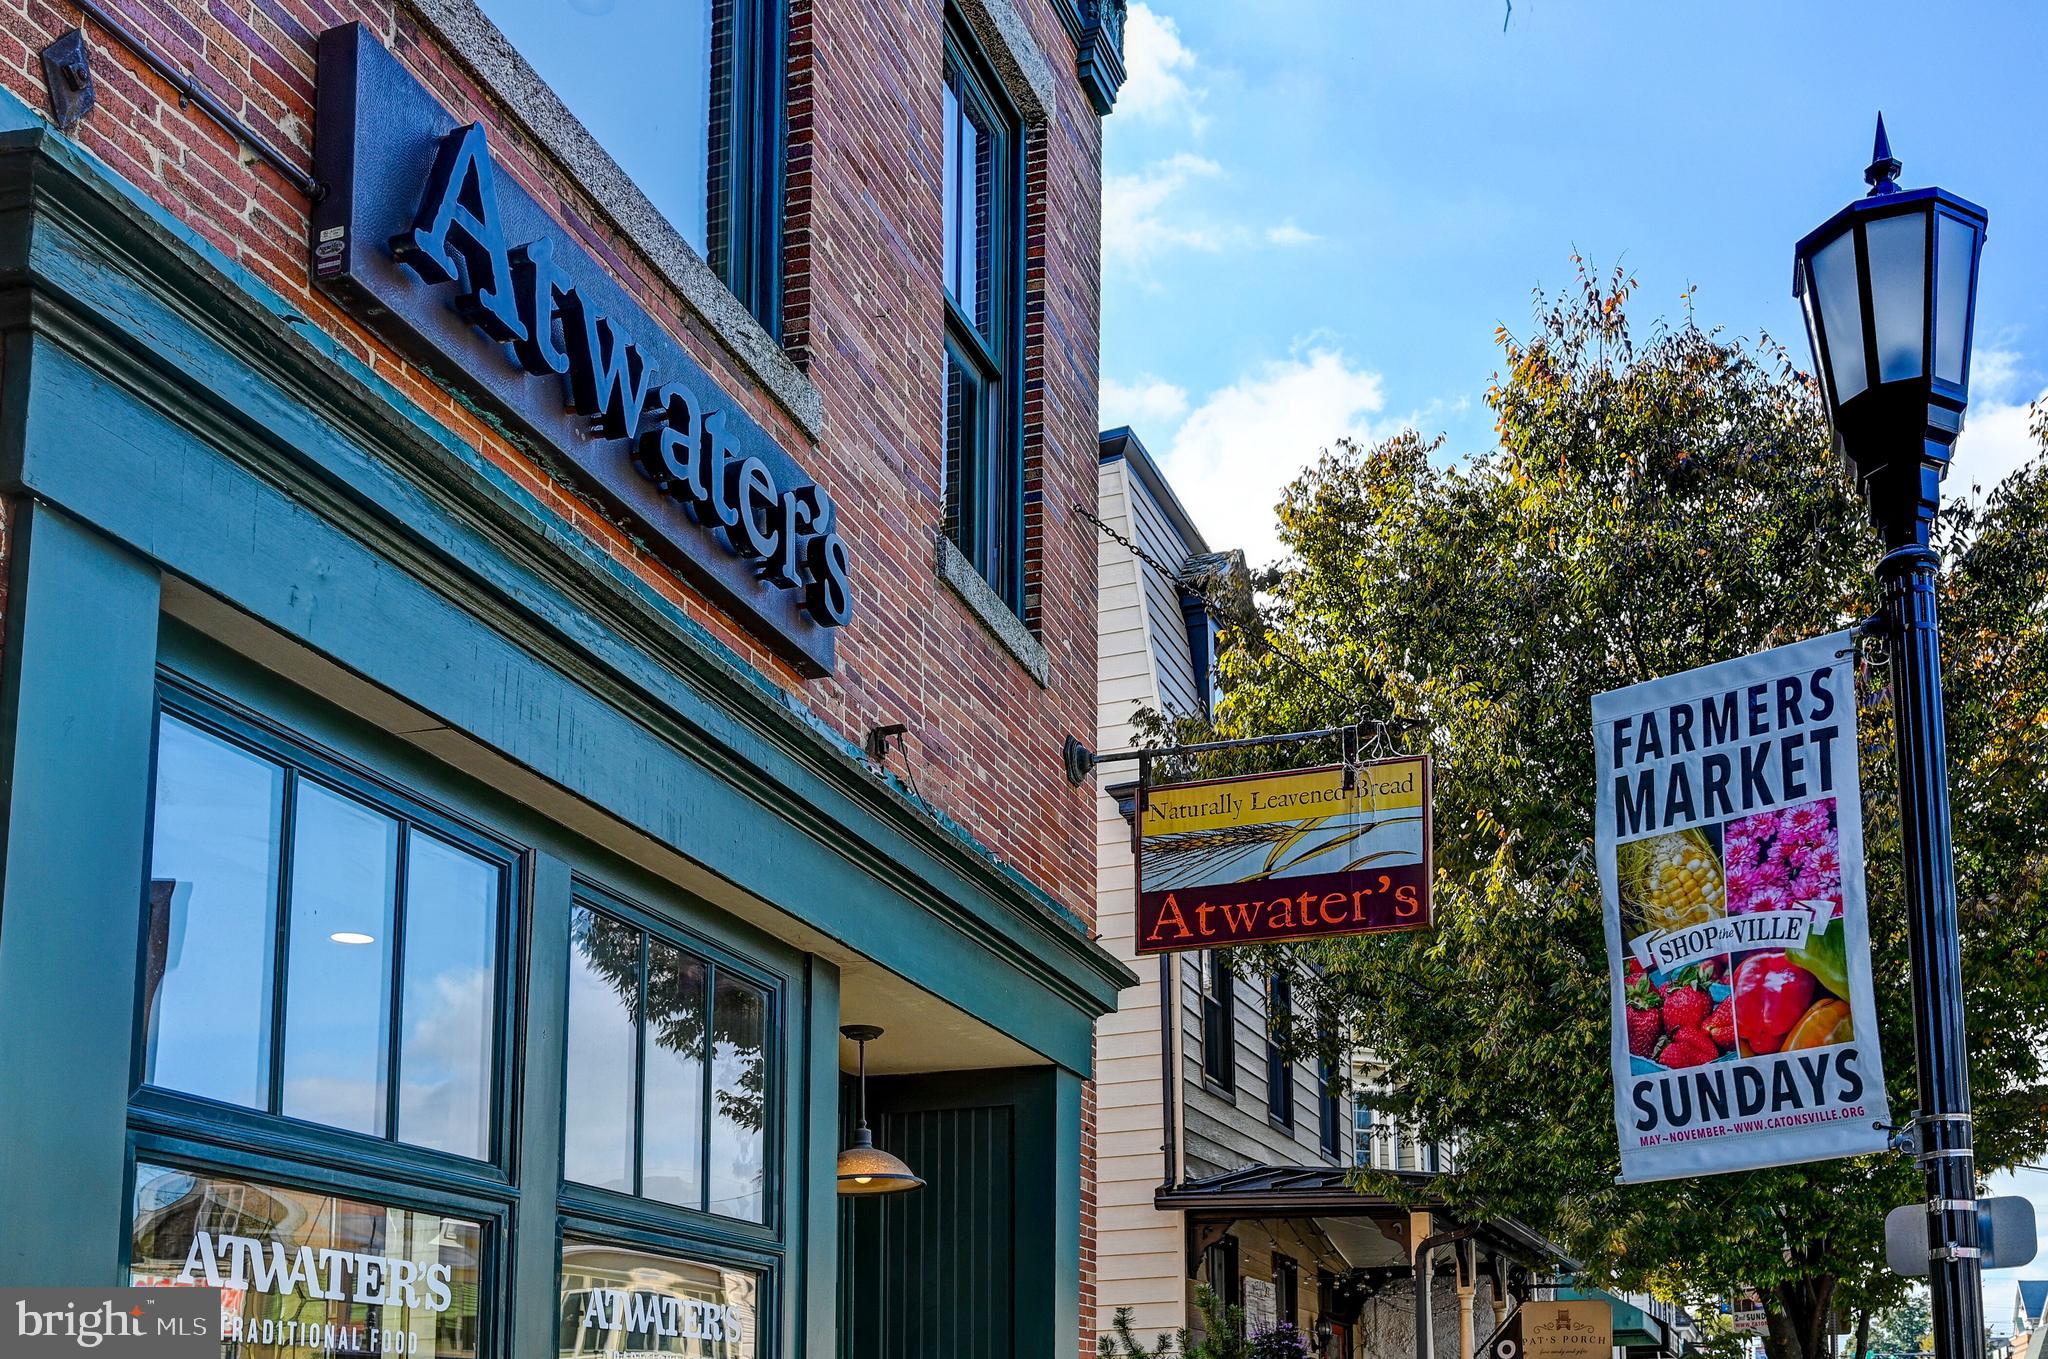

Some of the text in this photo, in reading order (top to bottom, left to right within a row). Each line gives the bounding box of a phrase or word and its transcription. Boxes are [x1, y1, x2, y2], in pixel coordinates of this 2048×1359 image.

[408, 121, 851, 627] Atwater's
[1613, 666, 1835, 770] FARMERS
[1149, 773, 1414, 822] Naturally Leavened Bread
[1615, 725, 1839, 838] MARKET
[1146, 874, 1419, 941] Atwater's
[1659, 916, 1803, 966] SHOP the VILLE
[1632, 1048, 1864, 1132] SUNDAYS
[176, 1231, 452, 1312] ATWATER'S
[370, 1328, 418, 1355] FOOD
[583, 1287, 742, 1344] ATWATER'S
[1563, 1335, 1606, 1345] PORCH
[1746, 1312, 1767, 1321] SUND
